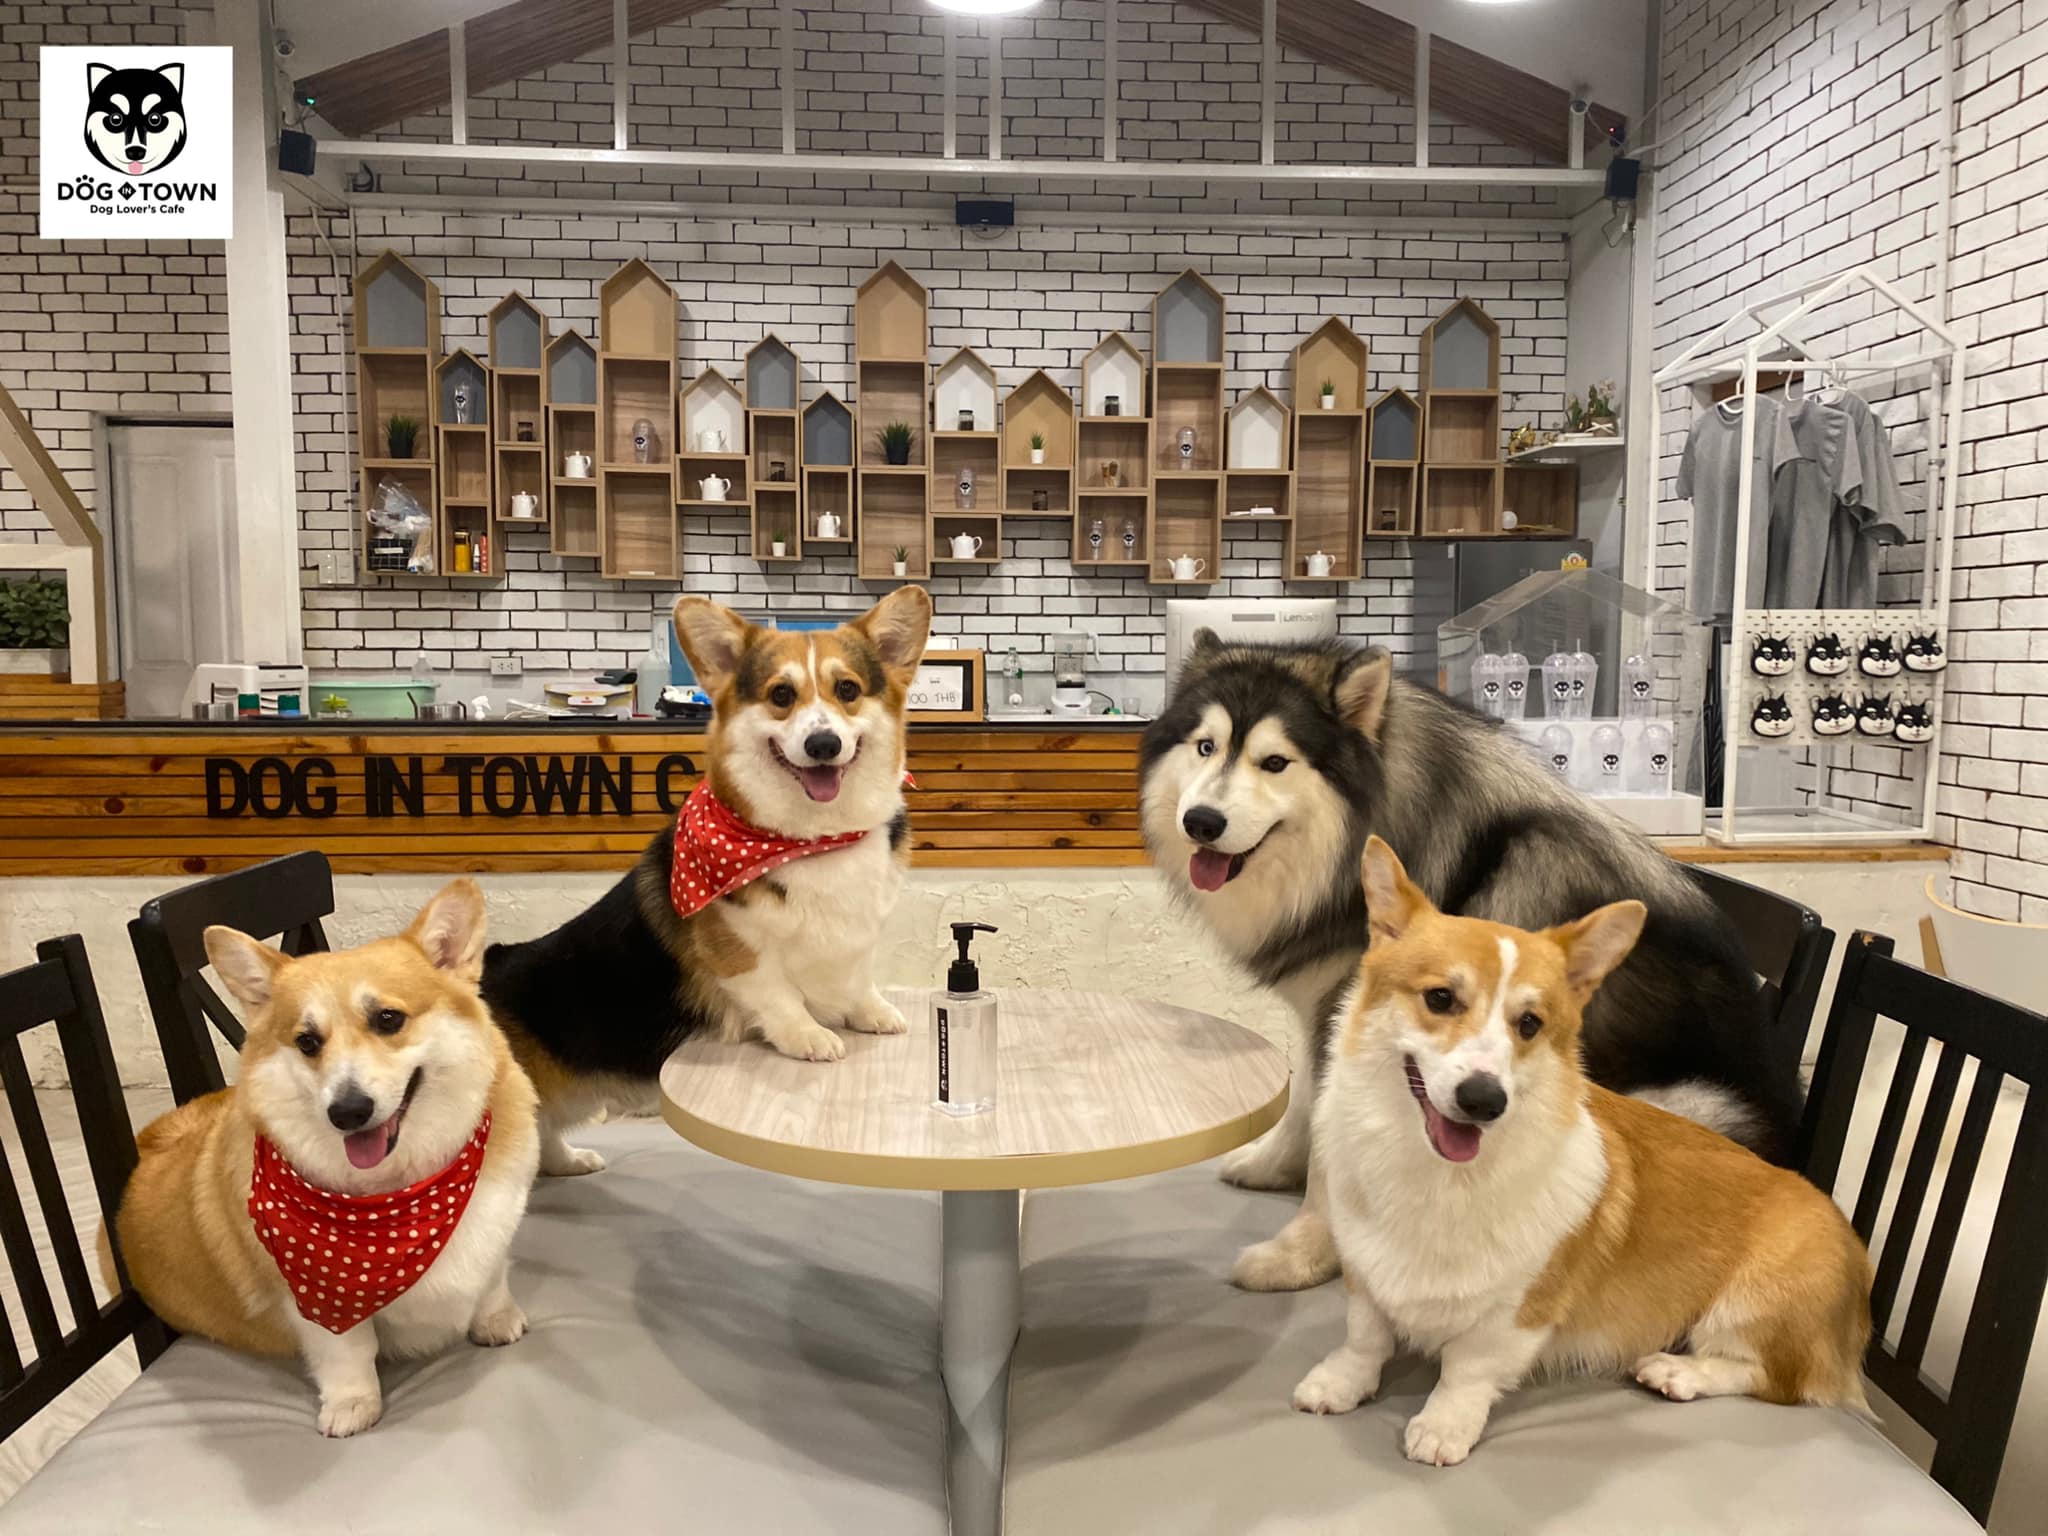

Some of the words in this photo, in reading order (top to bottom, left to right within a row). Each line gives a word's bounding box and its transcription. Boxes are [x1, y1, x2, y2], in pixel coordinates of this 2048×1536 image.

[205, 756, 338, 819] DOG
[364, 755, 425, 818] IN
[444, 755, 634, 818] TOWN
